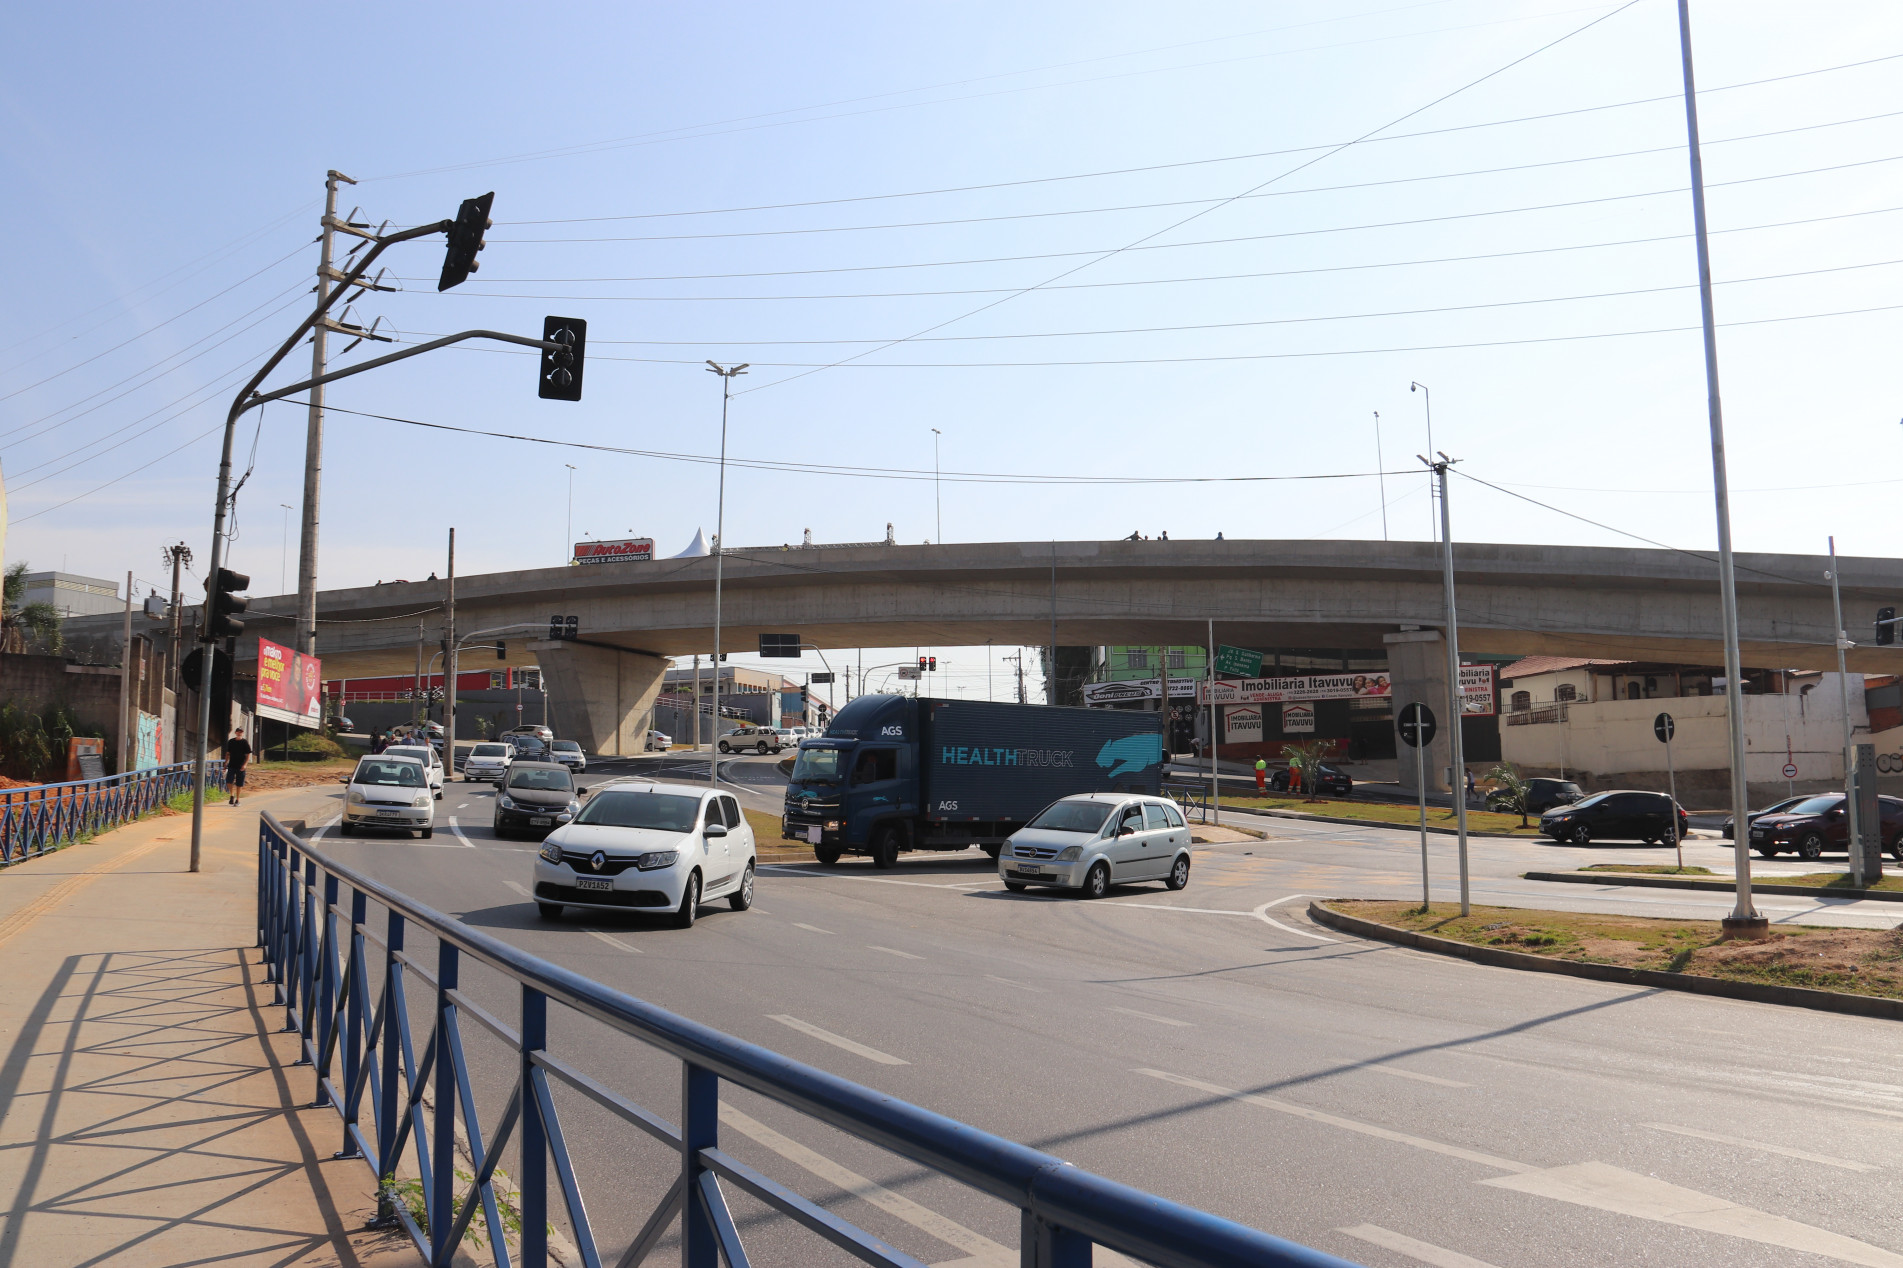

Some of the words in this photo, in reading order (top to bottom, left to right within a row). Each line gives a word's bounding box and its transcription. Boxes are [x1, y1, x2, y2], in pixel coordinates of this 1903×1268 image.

[592, 542, 650, 556] AutoZone
[606, 554, 649, 562] ACESSÓRIOS
[1242, 678, 1304, 691] Imobiliária
[1309, 677, 1352, 688] Itavuvu
[881, 726, 902, 736] AGS
[1231, 722, 1261, 730] ITAVUVU
[939, 800, 958, 810] AGS
[579, 881, 609, 890] PZV1A52
